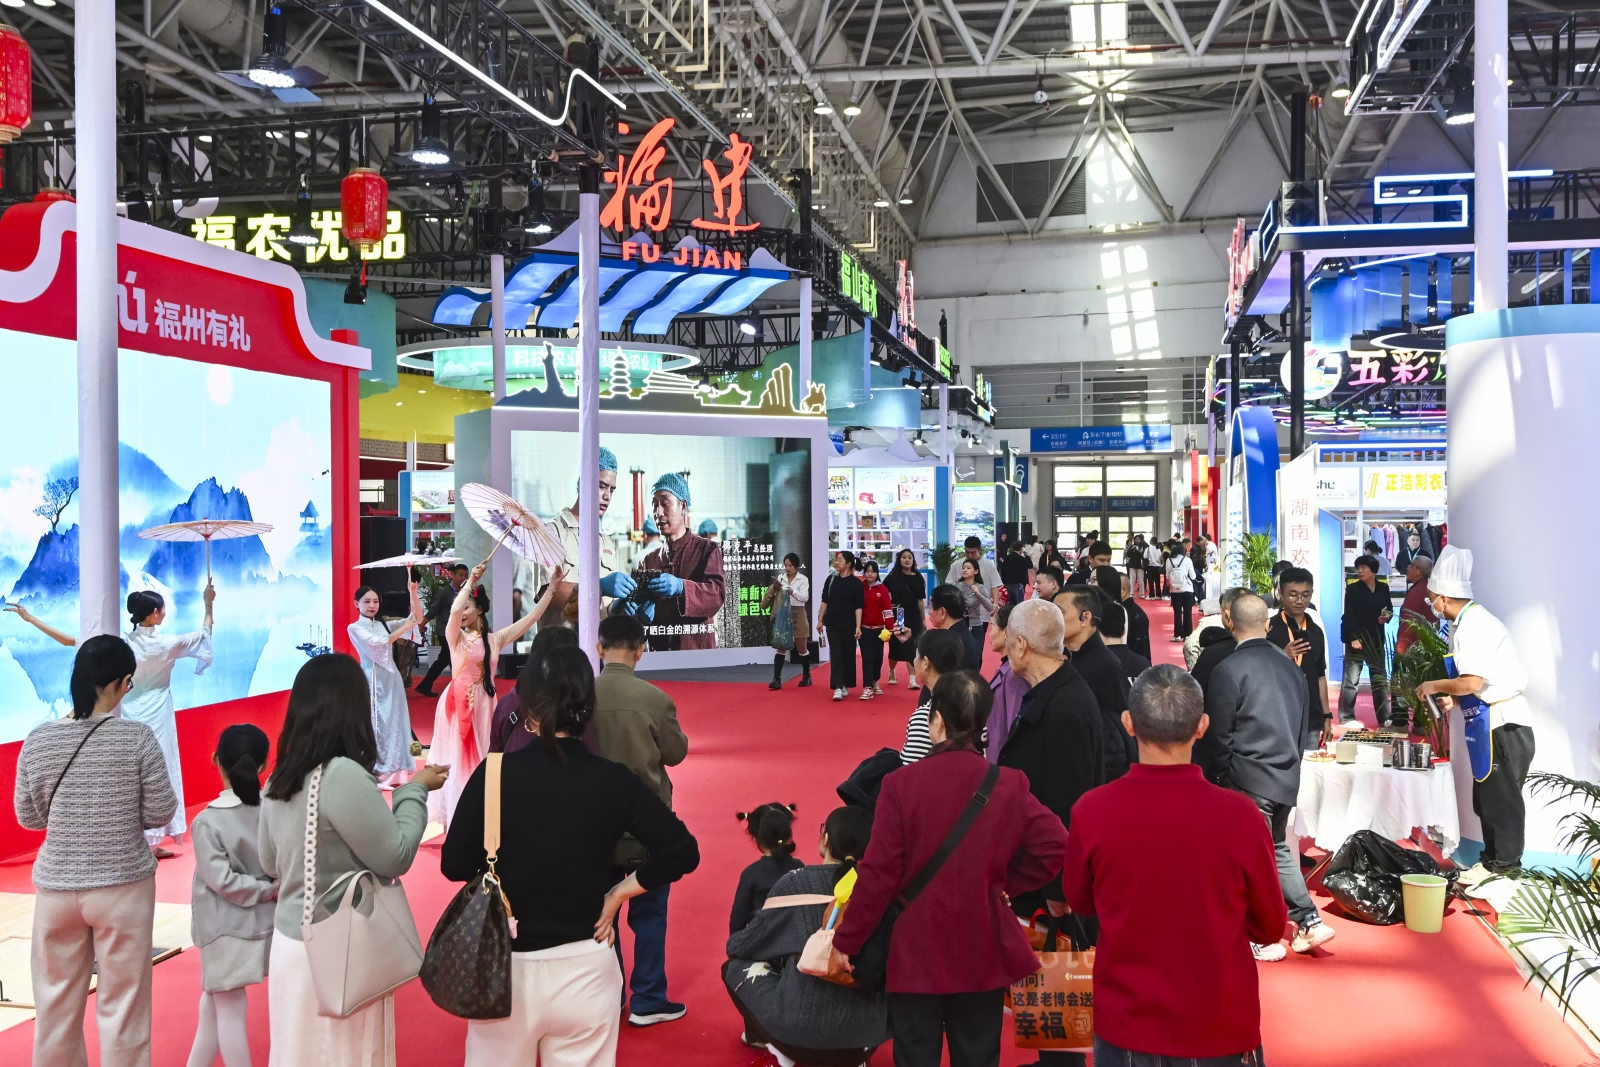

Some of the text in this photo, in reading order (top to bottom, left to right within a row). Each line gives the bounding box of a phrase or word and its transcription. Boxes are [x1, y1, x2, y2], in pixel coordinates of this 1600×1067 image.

[600, 118, 761, 237] 福建
[622, 241, 743, 271] FU JIAN
[153, 298, 252, 352] 福州有礼
[601, 351, 650, 371] 绿农业
